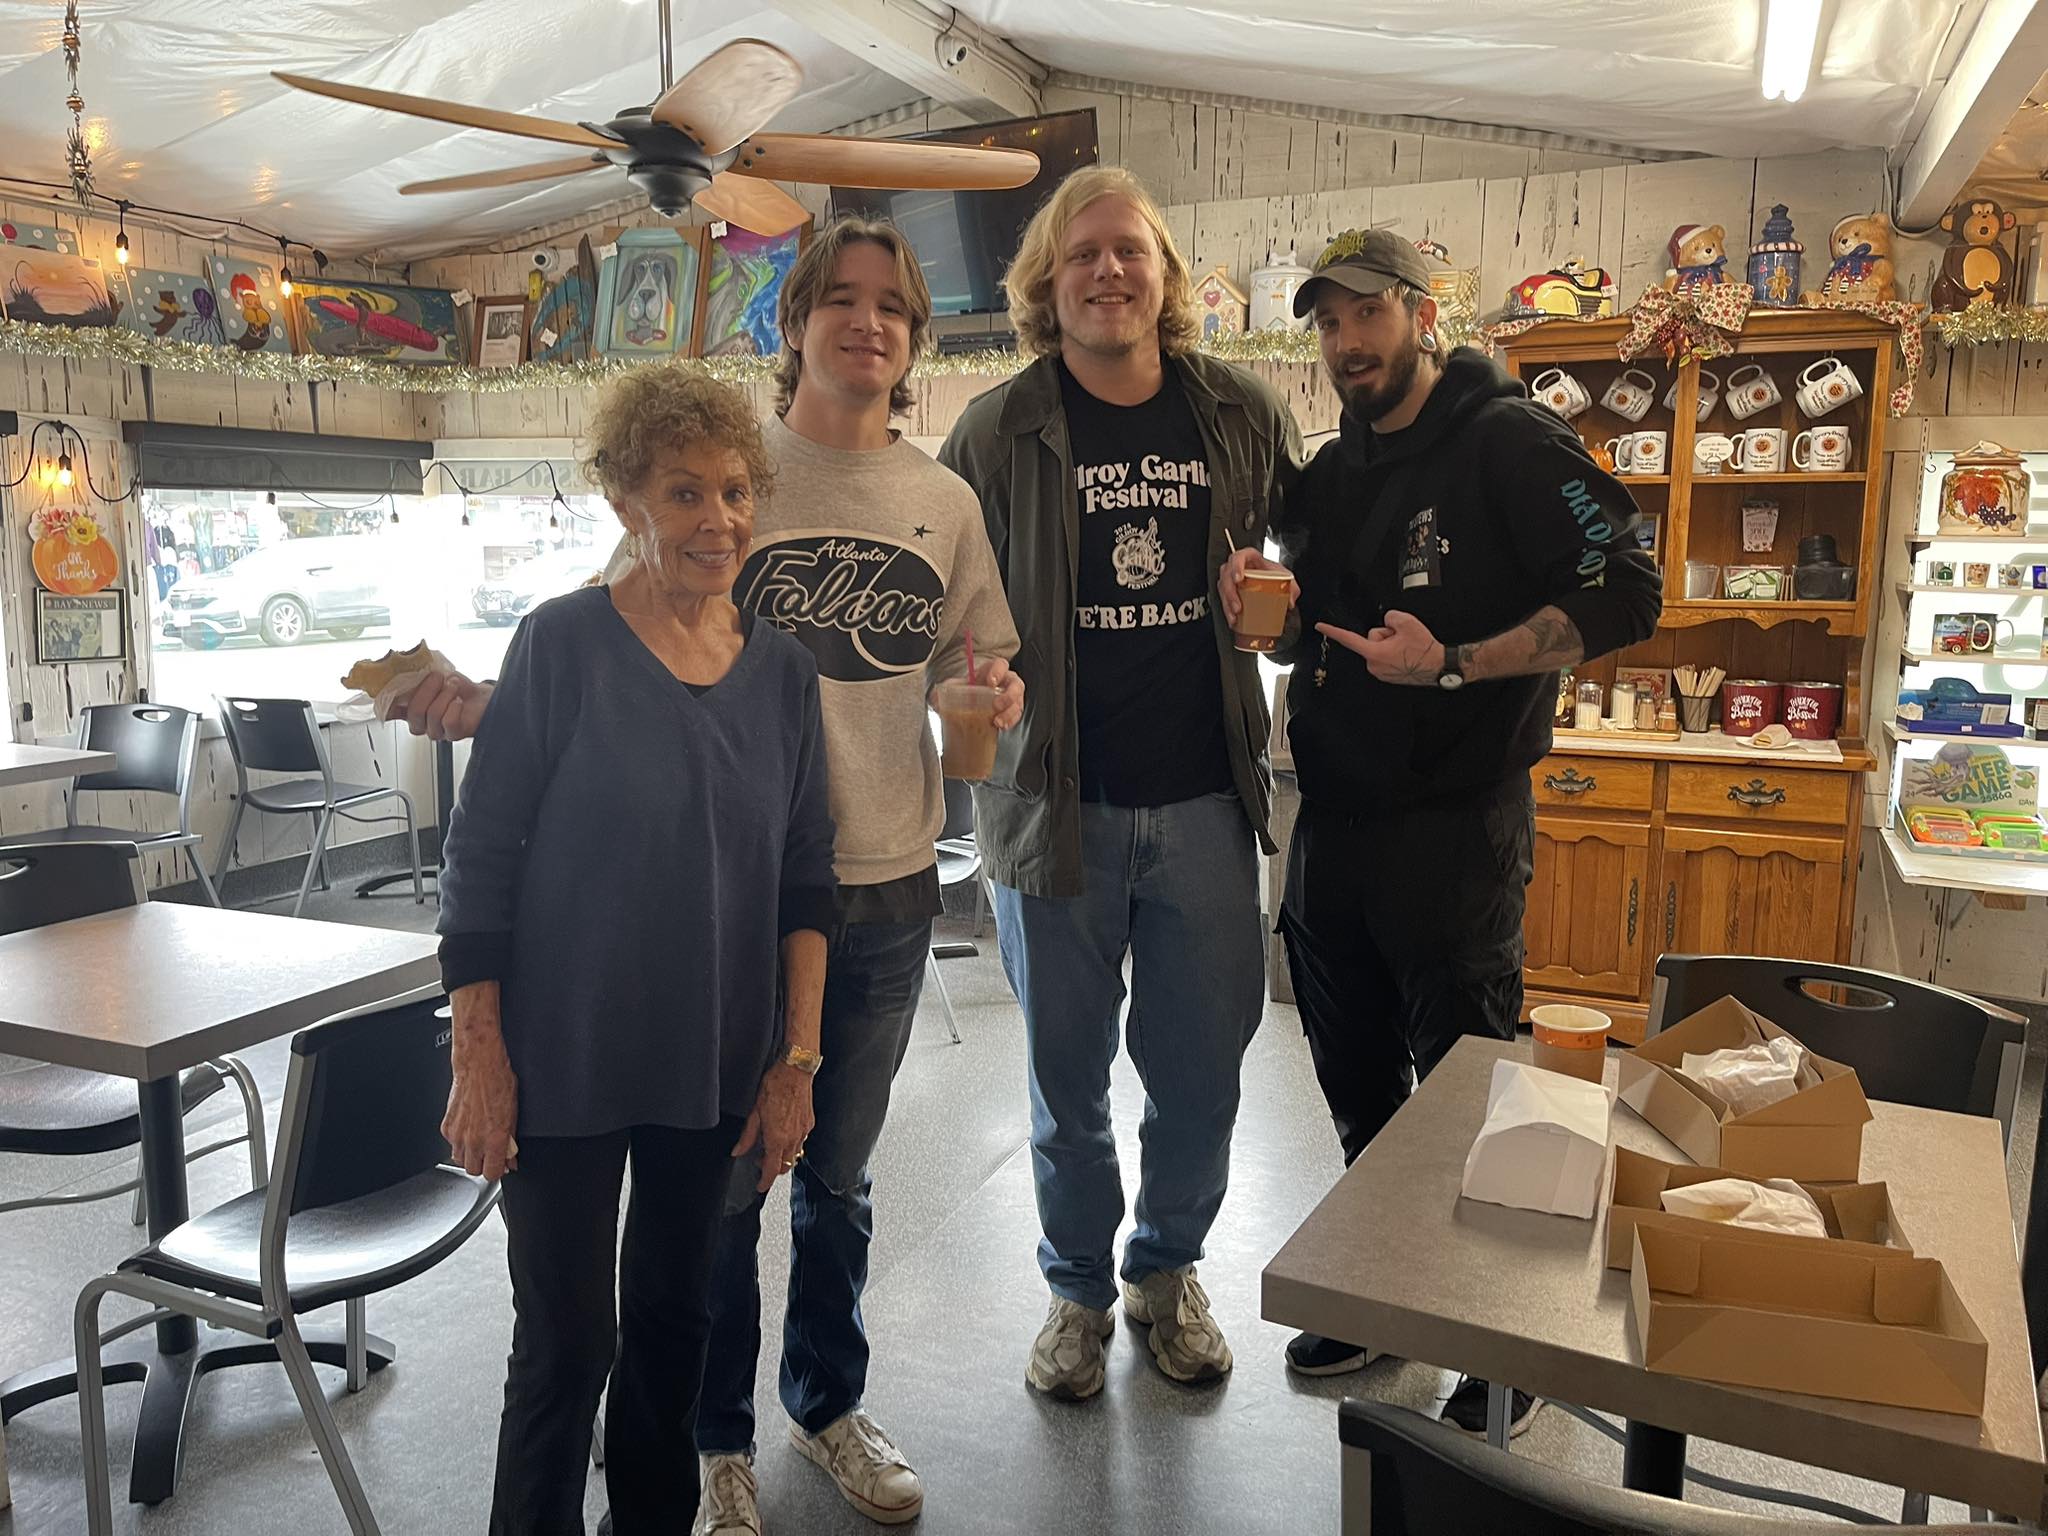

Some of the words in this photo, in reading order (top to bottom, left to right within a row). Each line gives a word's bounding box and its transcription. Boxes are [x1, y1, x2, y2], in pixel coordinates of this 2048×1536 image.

[1086, 480, 1188, 514] Festival
[816, 538, 889, 562] Atlanta
[54, 600, 72, 609] BAY
[81, 600, 109, 609] NEWS
[743, 550, 944, 640] Falcons
[1076, 604, 1137, 630] E'RE
[1942, 774, 2011, 803] GAME
